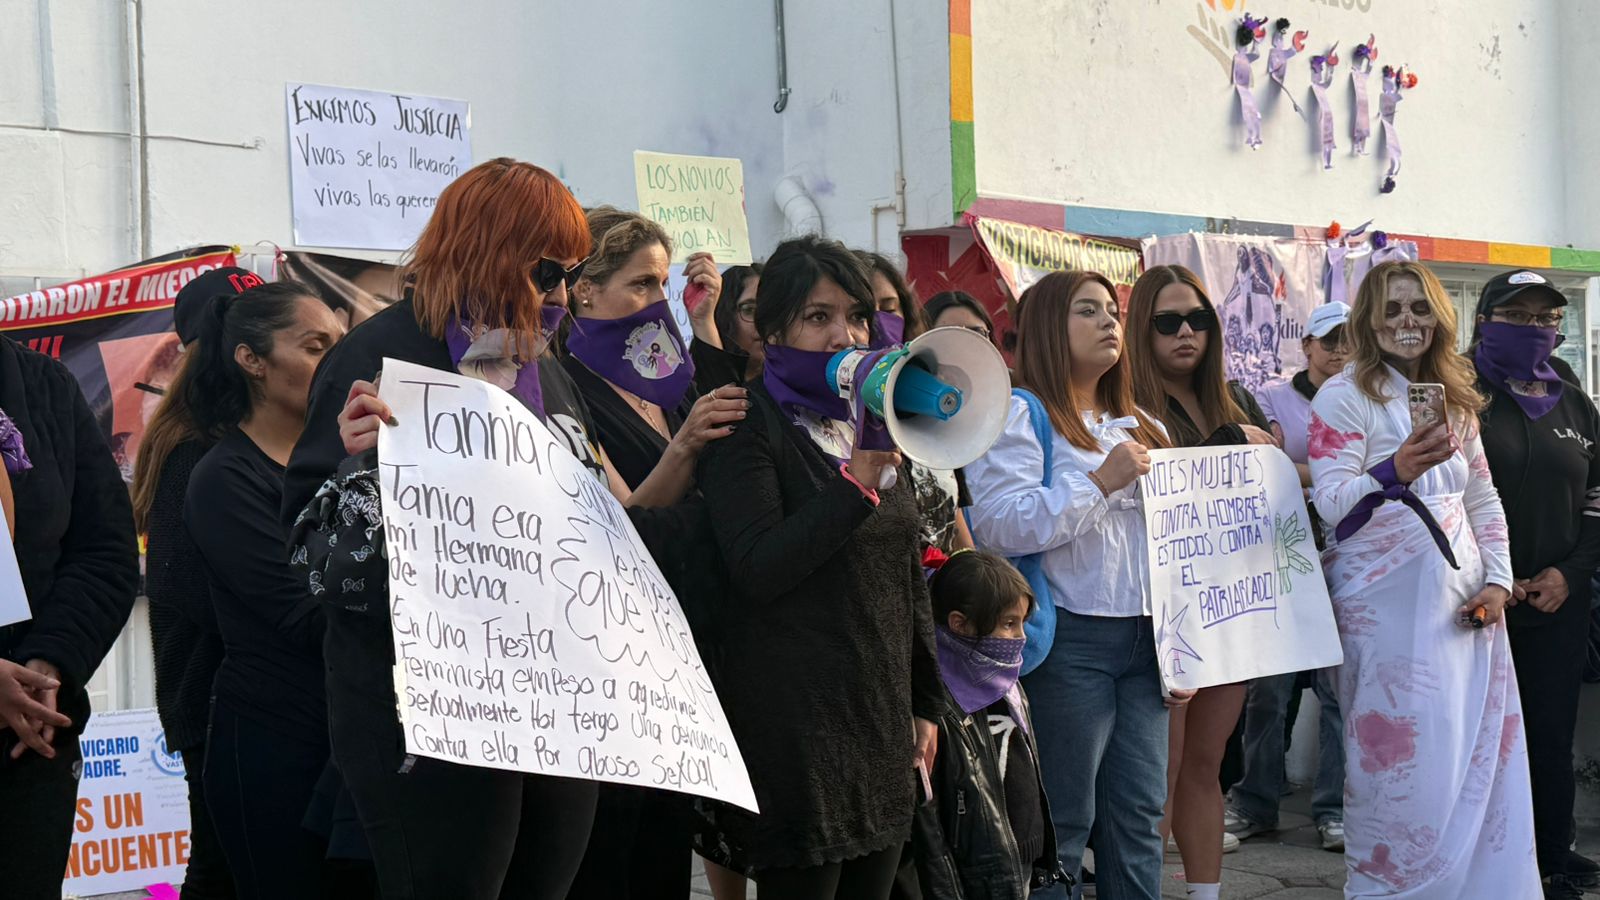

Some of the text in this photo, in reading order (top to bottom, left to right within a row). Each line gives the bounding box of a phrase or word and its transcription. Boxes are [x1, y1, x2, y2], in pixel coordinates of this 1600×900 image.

[292, 85, 463, 142] EXIGIMOS JUSTICIA
[357, 149, 373, 167] se
[378, 141, 398, 169] las
[314, 182, 361, 207] vivas
[368, 179, 391, 207] las
[646, 163, 735, 195] LOS NOVIOS
[647, 198, 716, 226] TAMBIÉN
[1084, 238, 1142, 284] SEXUAL
[104, 277, 132, 308] EL
[136, 262, 224, 303] MIED
[400, 380, 542, 475] Tannia
[1553, 428, 1594, 449] LAZY
[1144, 448, 1264, 498] NO ES MUJERES
[380, 461, 542, 545] Tania era
[1151, 502, 1202, 541] CONTRA
[386, 515, 417, 551] mi
[1219, 523, 1264, 555] CONTRA
[389, 546, 417, 587] de
[1181, 564, 1202, 587] EL
[1199, 571, 1274, 622] PATRIARCADO
[391, 595, 420, 638] En
[481, 611, 558, 663] Fiesta
[602, 678, 617, 700] a
[81, 736, 140, 758] VICARIO
[481, 730, 519, 766] ella
[578, 746, 640, 780] abuso
[75, 791, 144, 834] S UN
